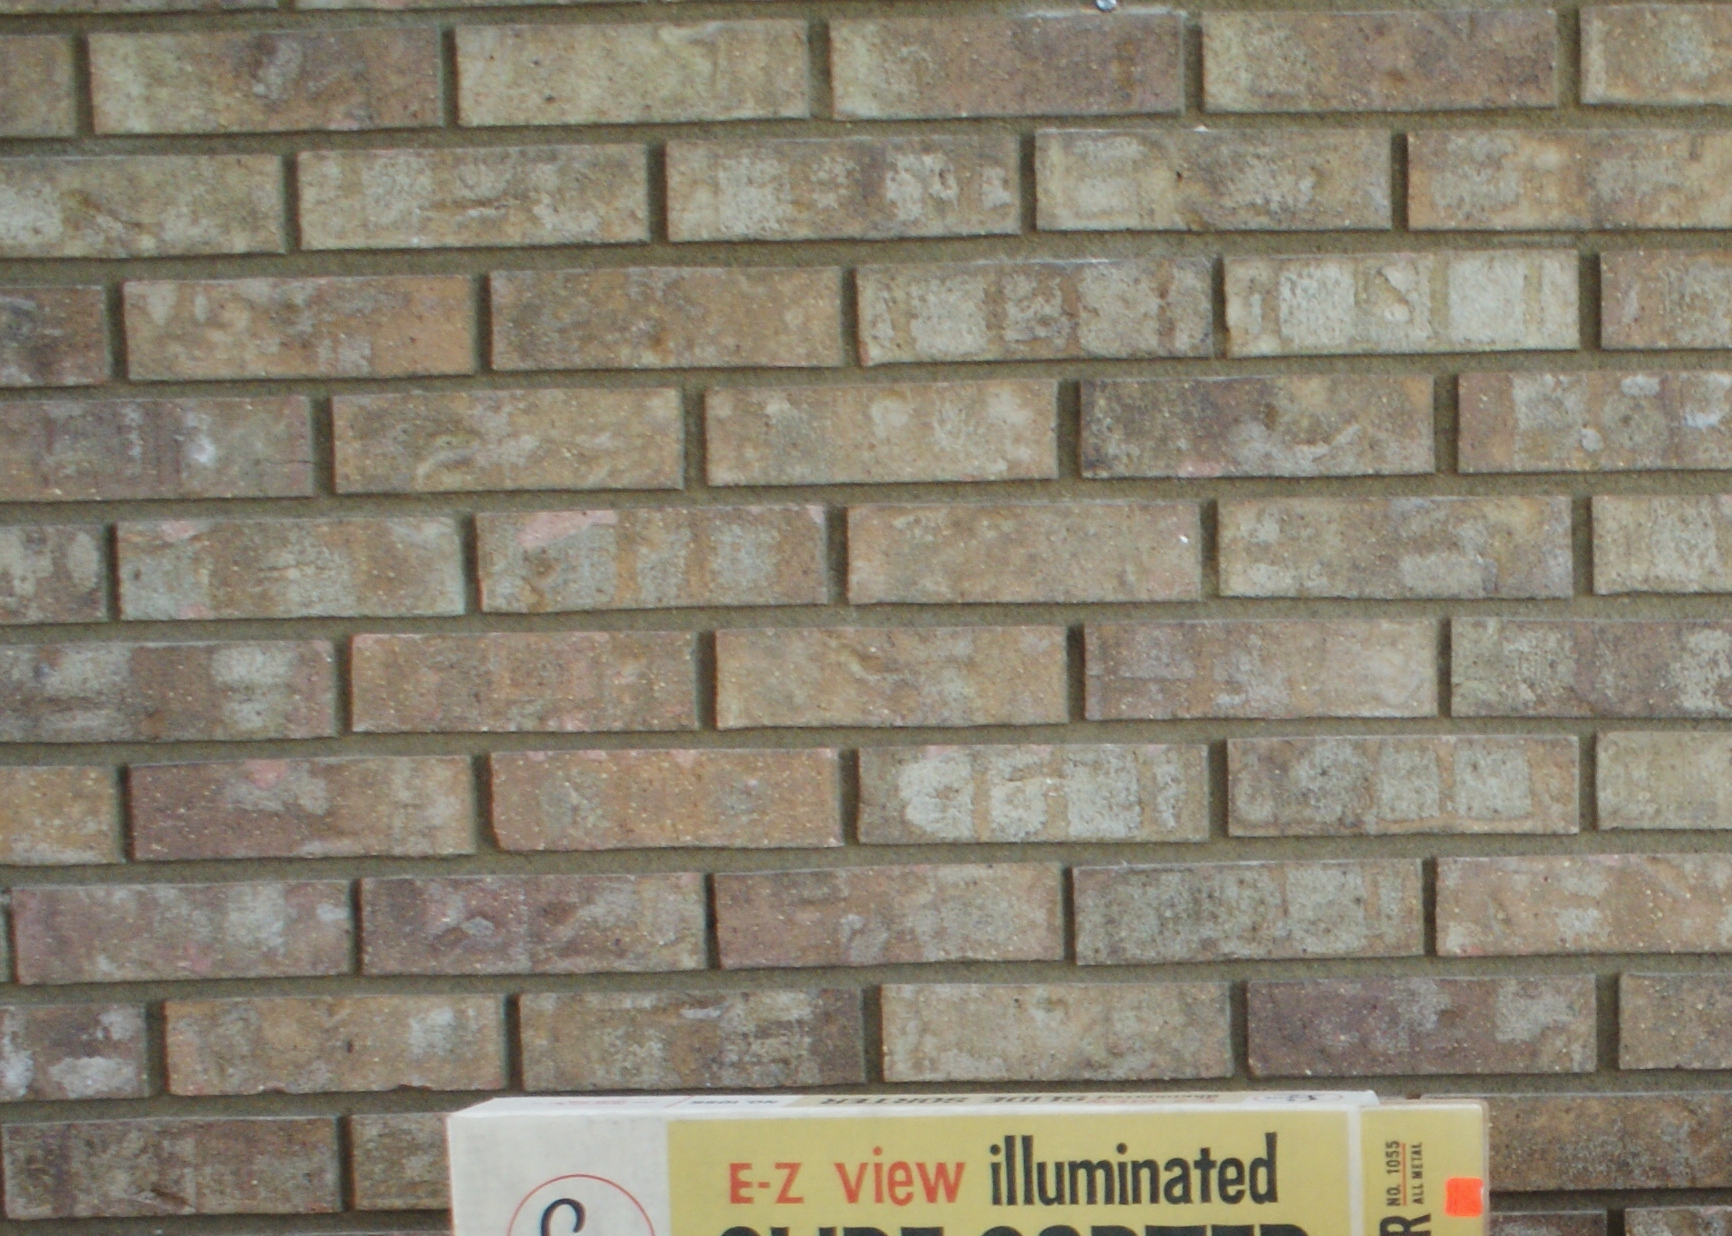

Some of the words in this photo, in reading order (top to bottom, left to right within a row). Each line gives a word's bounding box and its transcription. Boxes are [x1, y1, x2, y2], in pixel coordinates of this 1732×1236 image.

[729, 1162, 805, 1205] E-Z
[835, 1146, 965, 1206] view
[990, 1132, 1278, 1206] illuminated
[1384, 1139, 1401, 1175] 1055
[1409, 1141, 1424, 1180] METAL
[1385, 1180, 1400, 1207] NO.
[1410, 1183, 1425, 1206] ALL
